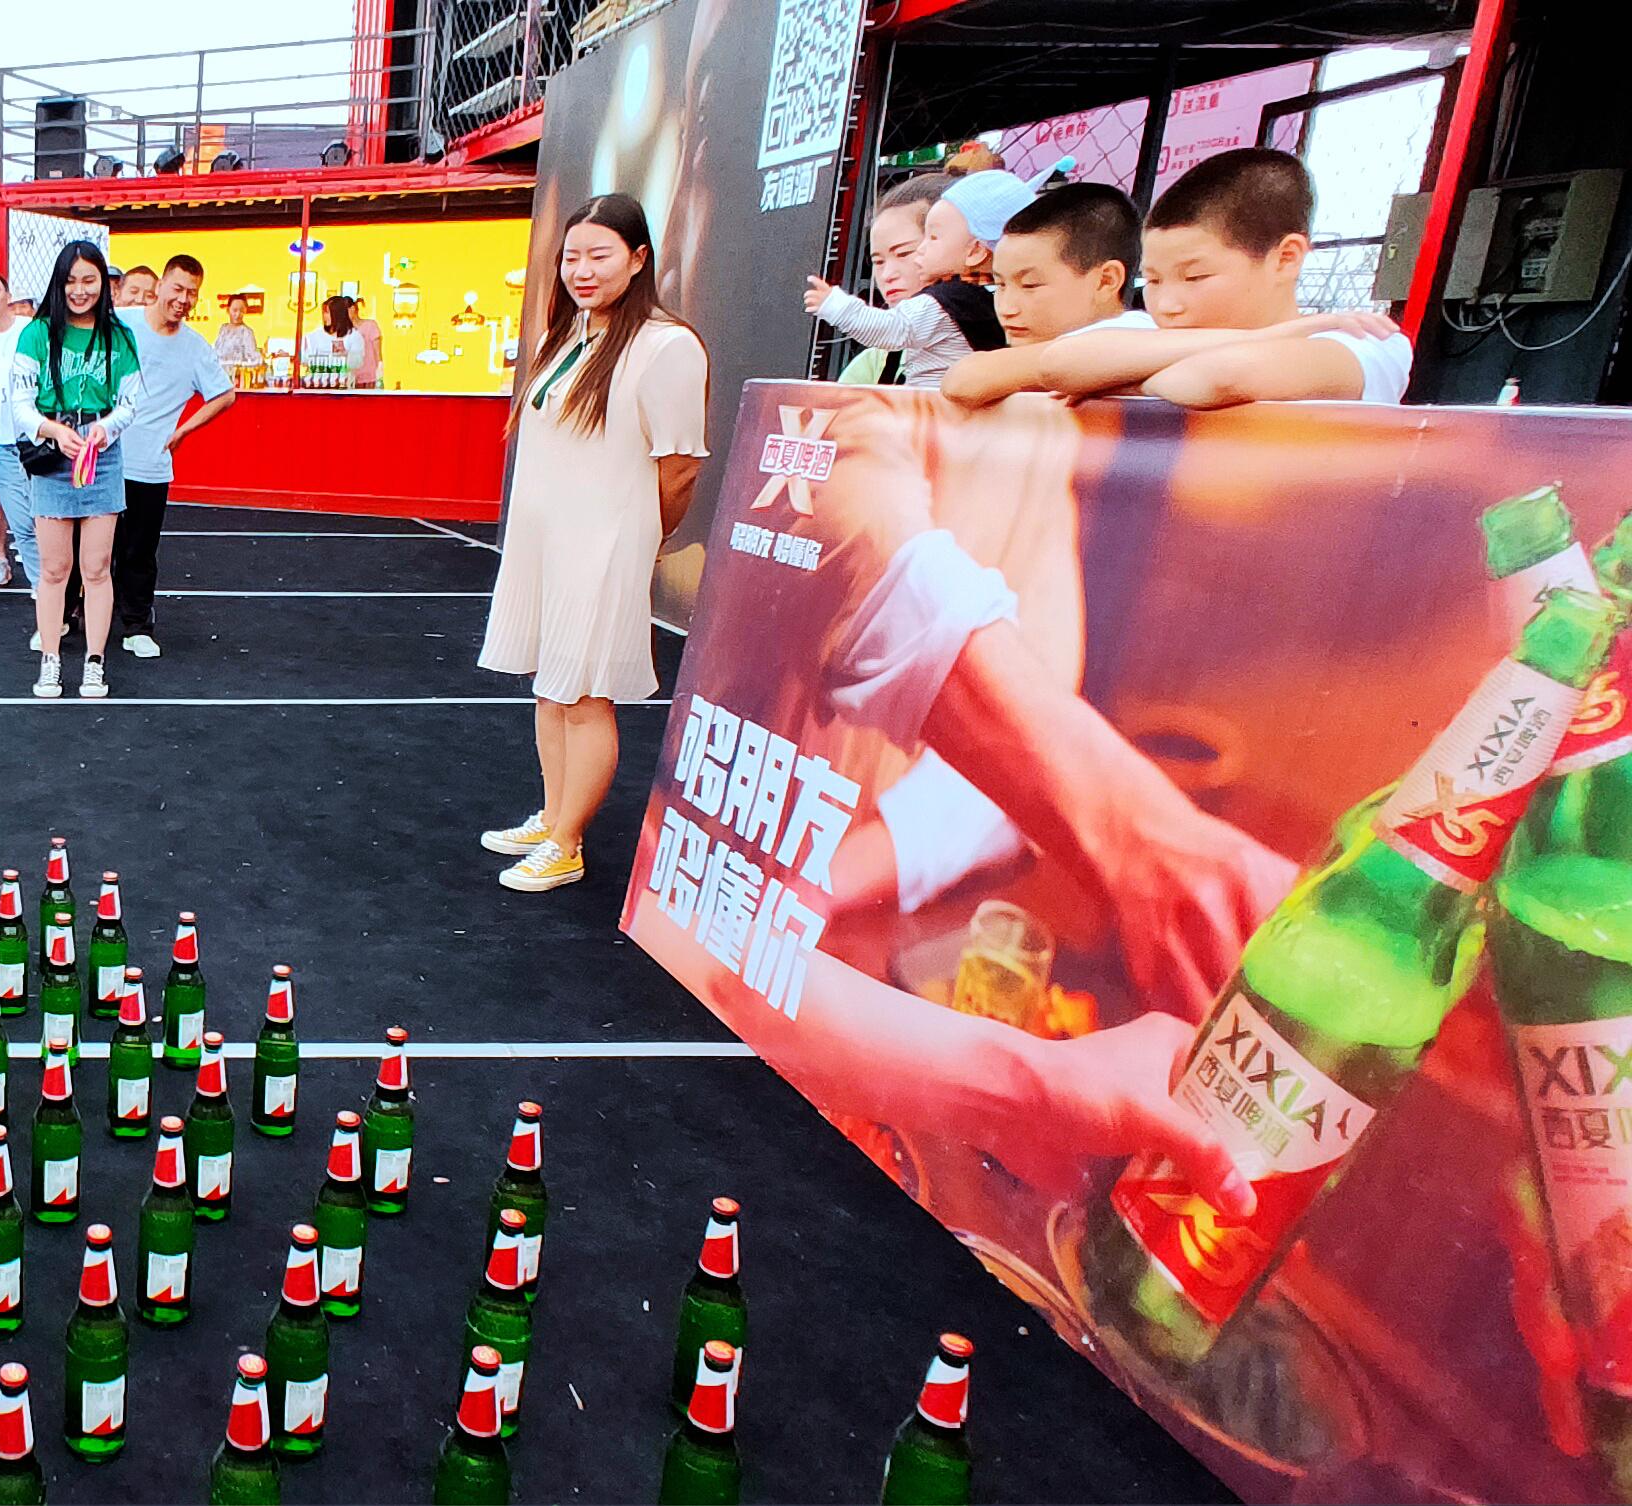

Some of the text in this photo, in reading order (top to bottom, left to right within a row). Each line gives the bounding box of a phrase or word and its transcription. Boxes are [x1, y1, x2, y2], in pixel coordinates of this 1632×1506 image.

[762, 436, 835, 480] 西夏啤酒
[1466, 696, 1537, 782] XIXIA
[1196, 1053, 1293, 1158] 西夏啤酒
[1215, 1013, 1327, 1143] XIXIA
